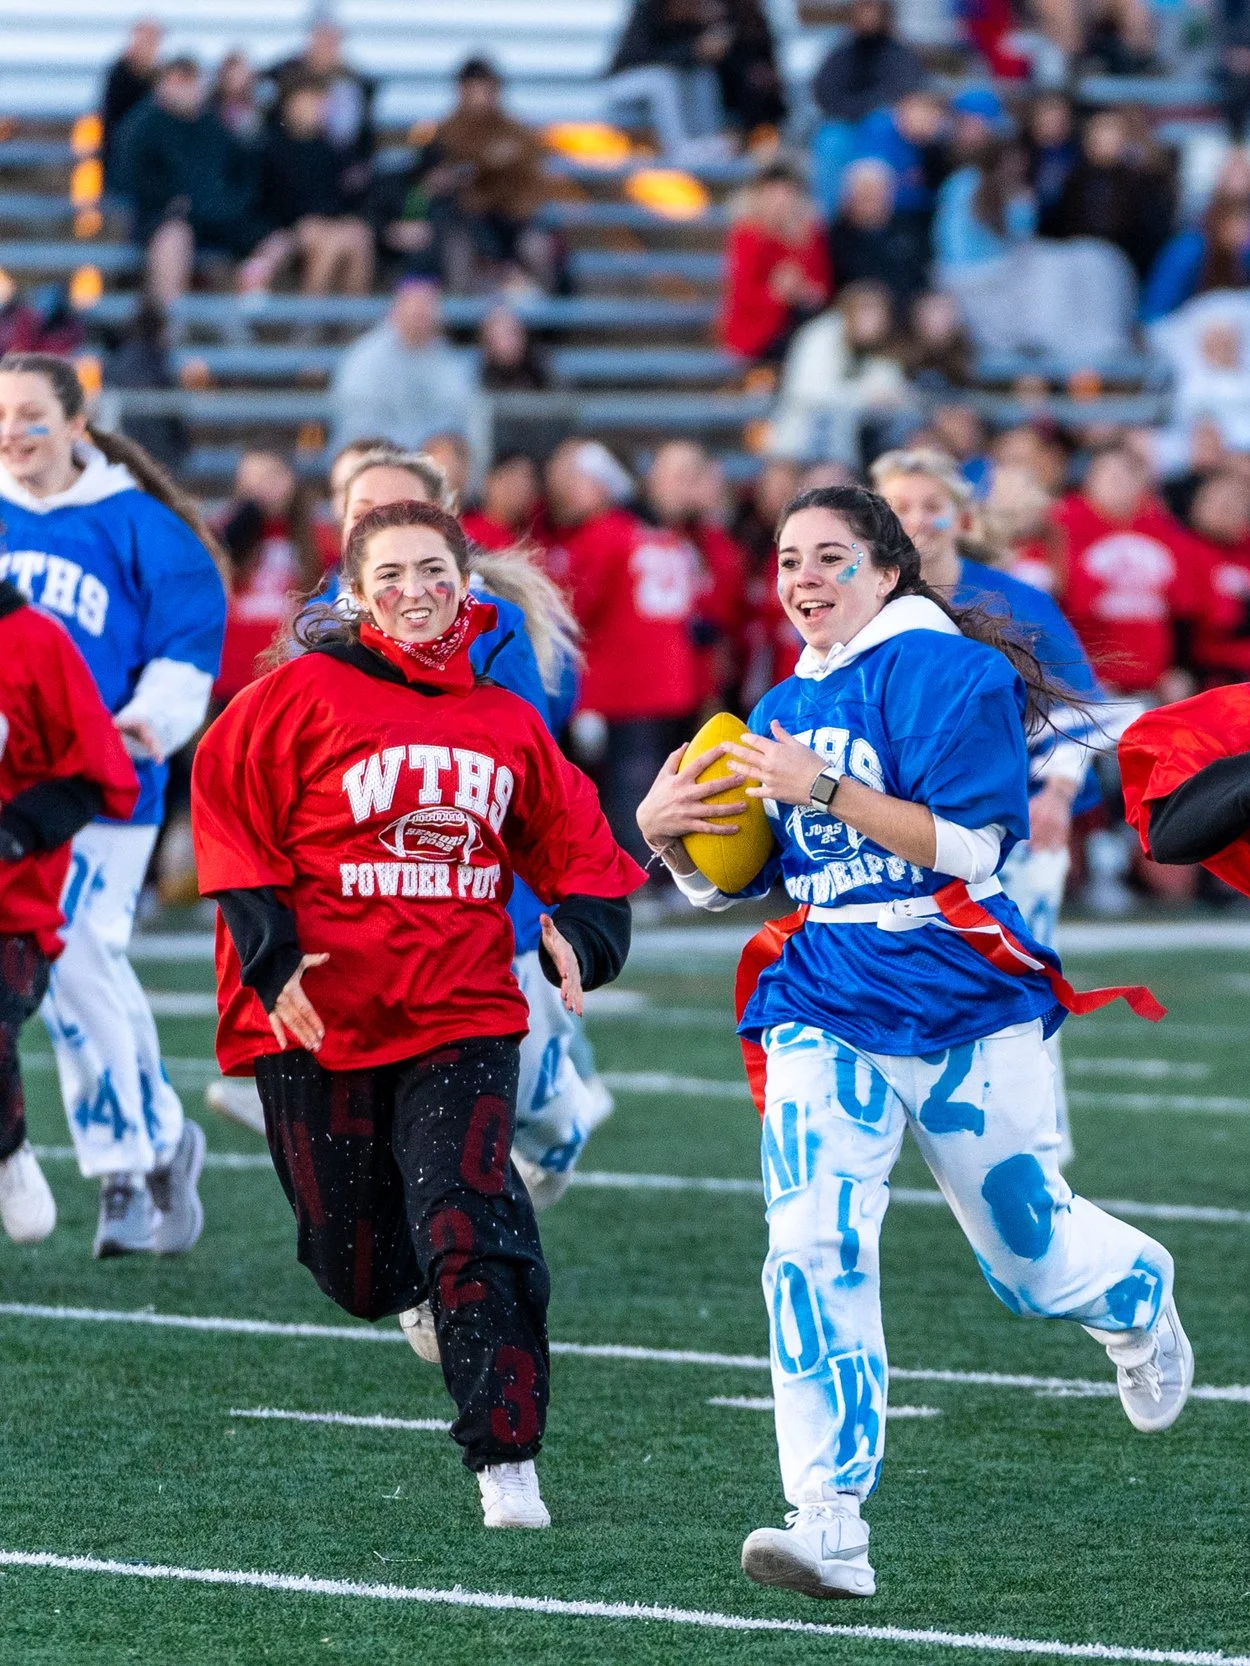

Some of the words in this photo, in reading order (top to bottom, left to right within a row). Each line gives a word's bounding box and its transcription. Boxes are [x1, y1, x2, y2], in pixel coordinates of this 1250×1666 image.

[0, 550, 109, 637] THS
[342, 745, 514, 834] WTHS
[340, 863, 452, 897] POWDER
